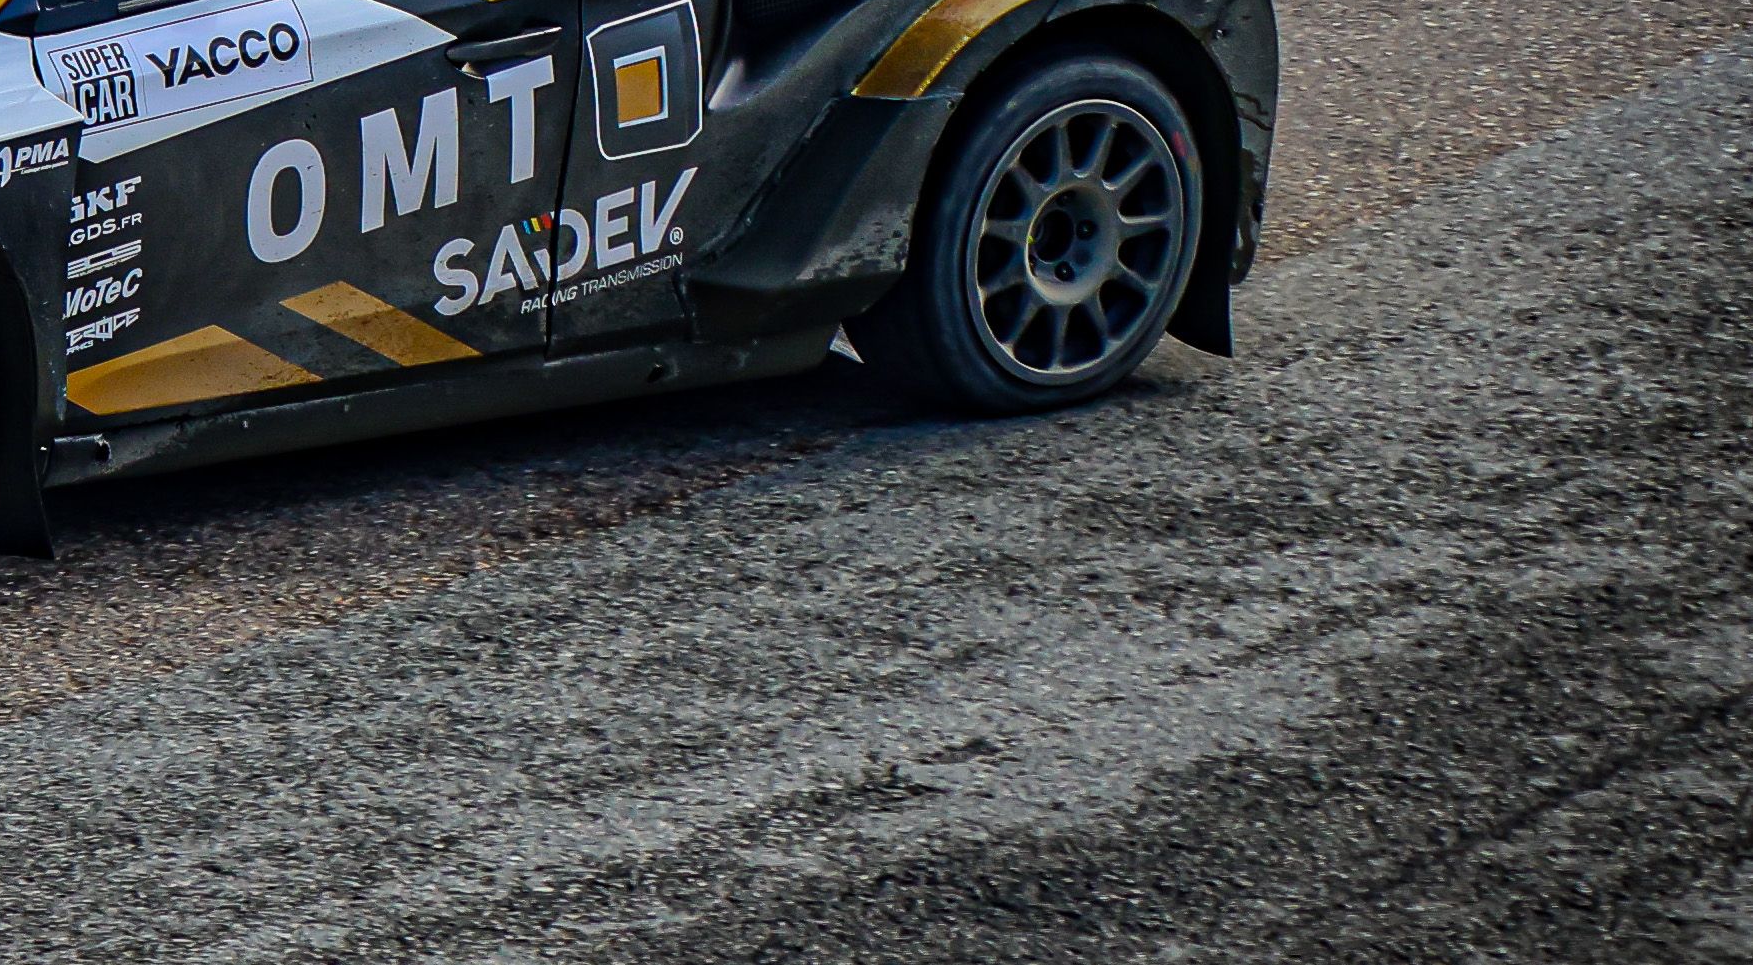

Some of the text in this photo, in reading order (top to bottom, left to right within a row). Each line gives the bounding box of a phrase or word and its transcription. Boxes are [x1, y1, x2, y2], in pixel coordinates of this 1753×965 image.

[60, 41, 132, 82] SUPER
[144, 21, 302, 89] YACCO
[78, 74, 135, 126] CAR
[246, 55, 555, 264] OMT
[68, 212, 143, 248] GDS.FR
[580, 251, 684, 295] TRANSMISSION
